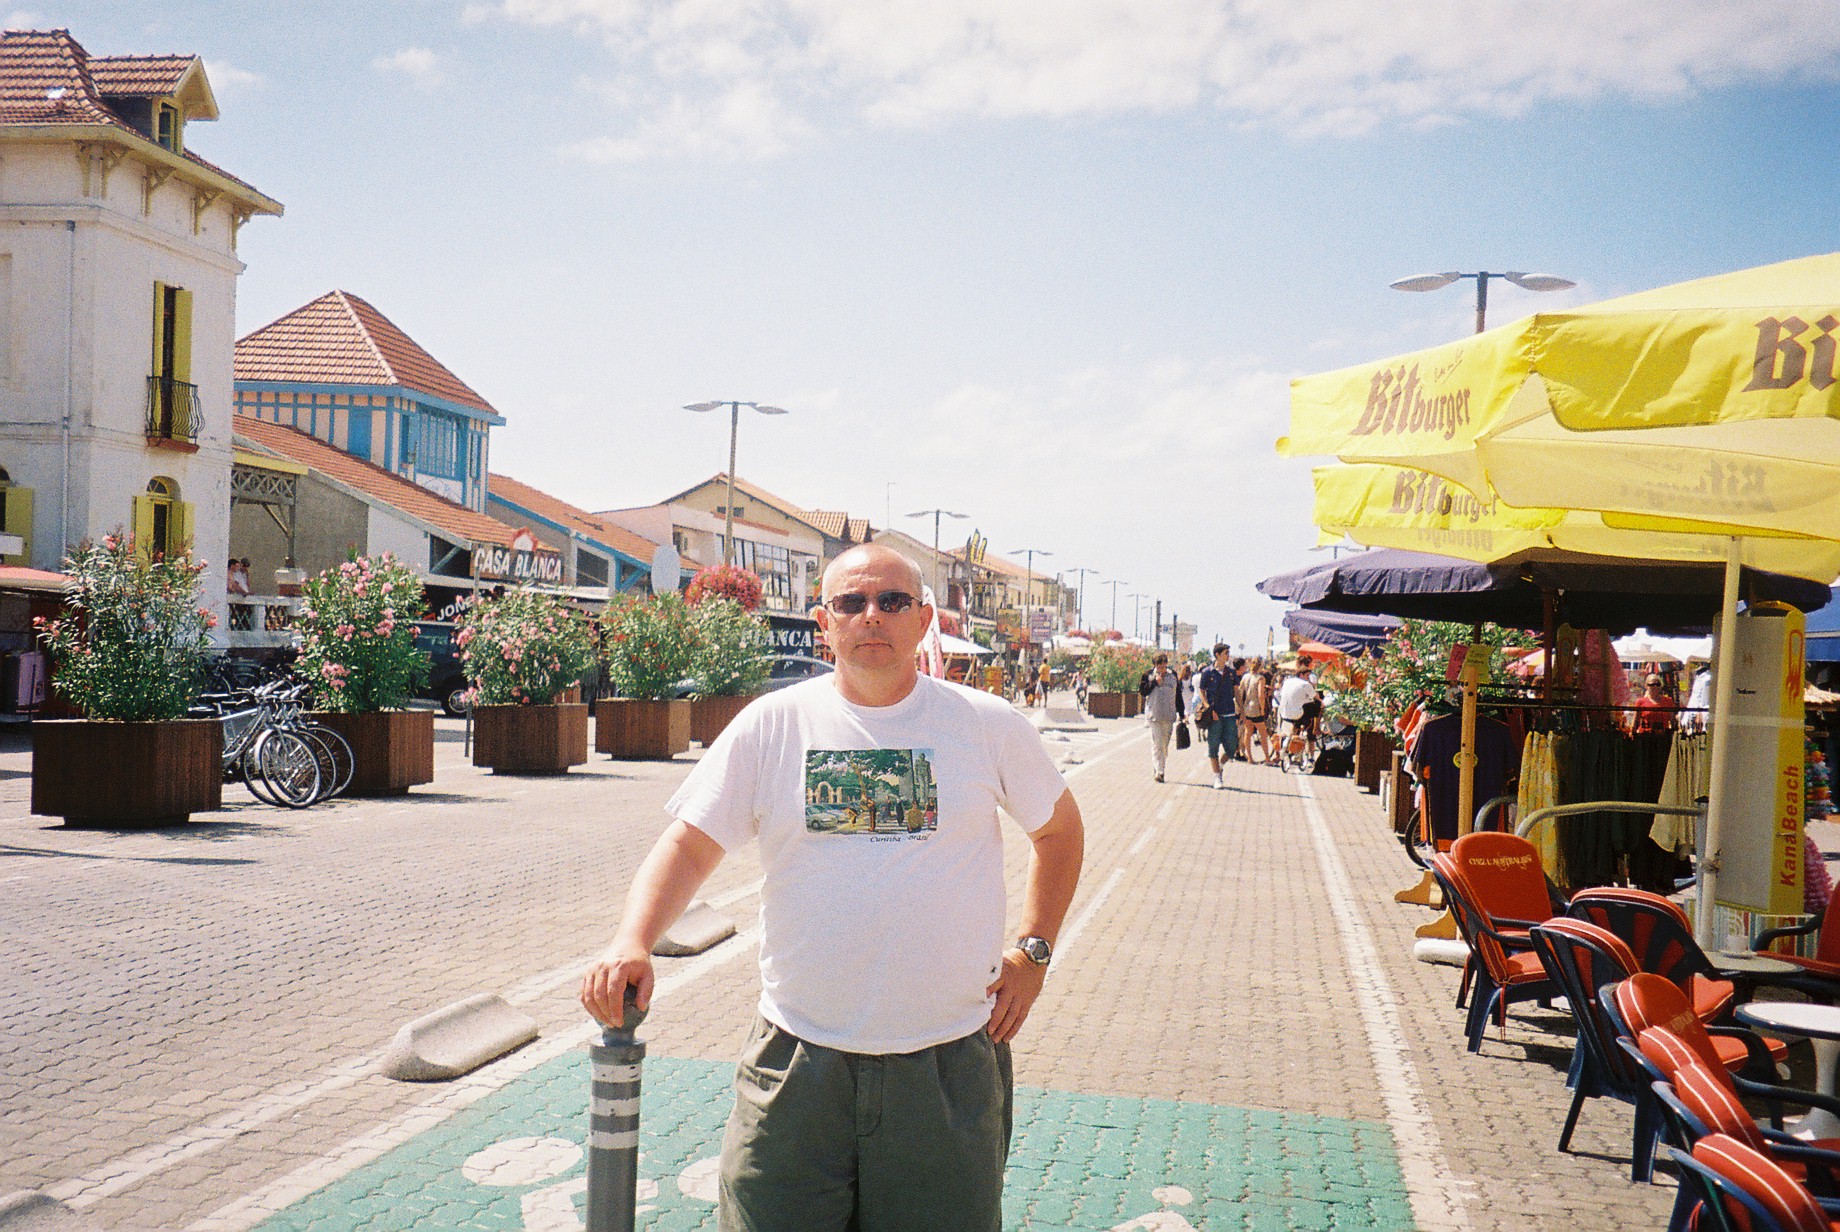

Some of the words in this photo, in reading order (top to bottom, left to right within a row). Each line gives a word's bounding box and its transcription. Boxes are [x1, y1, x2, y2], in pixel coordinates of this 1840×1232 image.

[1347, 362, 1470, 440] Bitburger
[474, 548, 510, 576] CASA
[514, 554, 562, 582] BLANCA
[743, 629, 812, 647] LANCA
